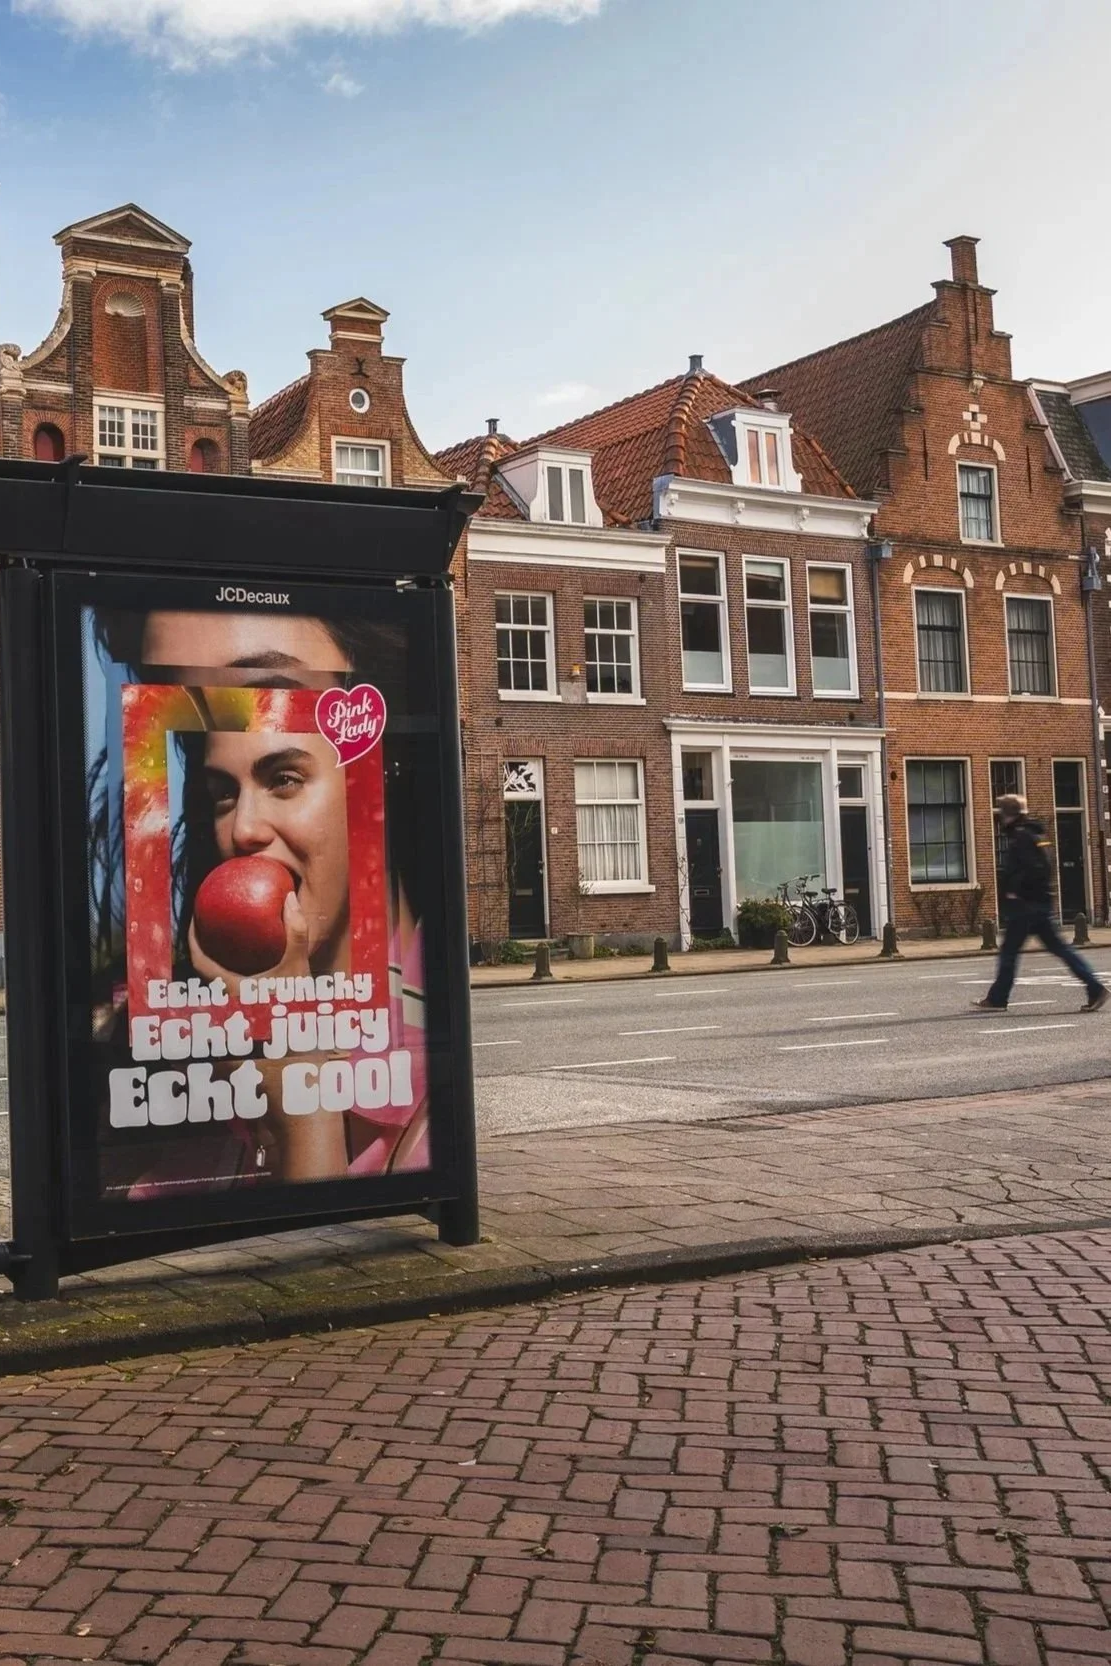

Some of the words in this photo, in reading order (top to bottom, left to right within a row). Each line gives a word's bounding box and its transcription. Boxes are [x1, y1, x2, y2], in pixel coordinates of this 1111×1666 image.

[215, 587, 290, 605] JCDecaux
[327, 692, 373, 728] Pink
[334, 714, 377, 745] Lady
[148, 978, 228, 1008] Echt
[240, 972, 372, 1004] crunchy
[132, 1011, 253, 1061] Echt
[263, 1002, 389, 1059] juicy
[109, 1060, 267, 1128] Echt
[282, 1050, 413, 1115] cool
